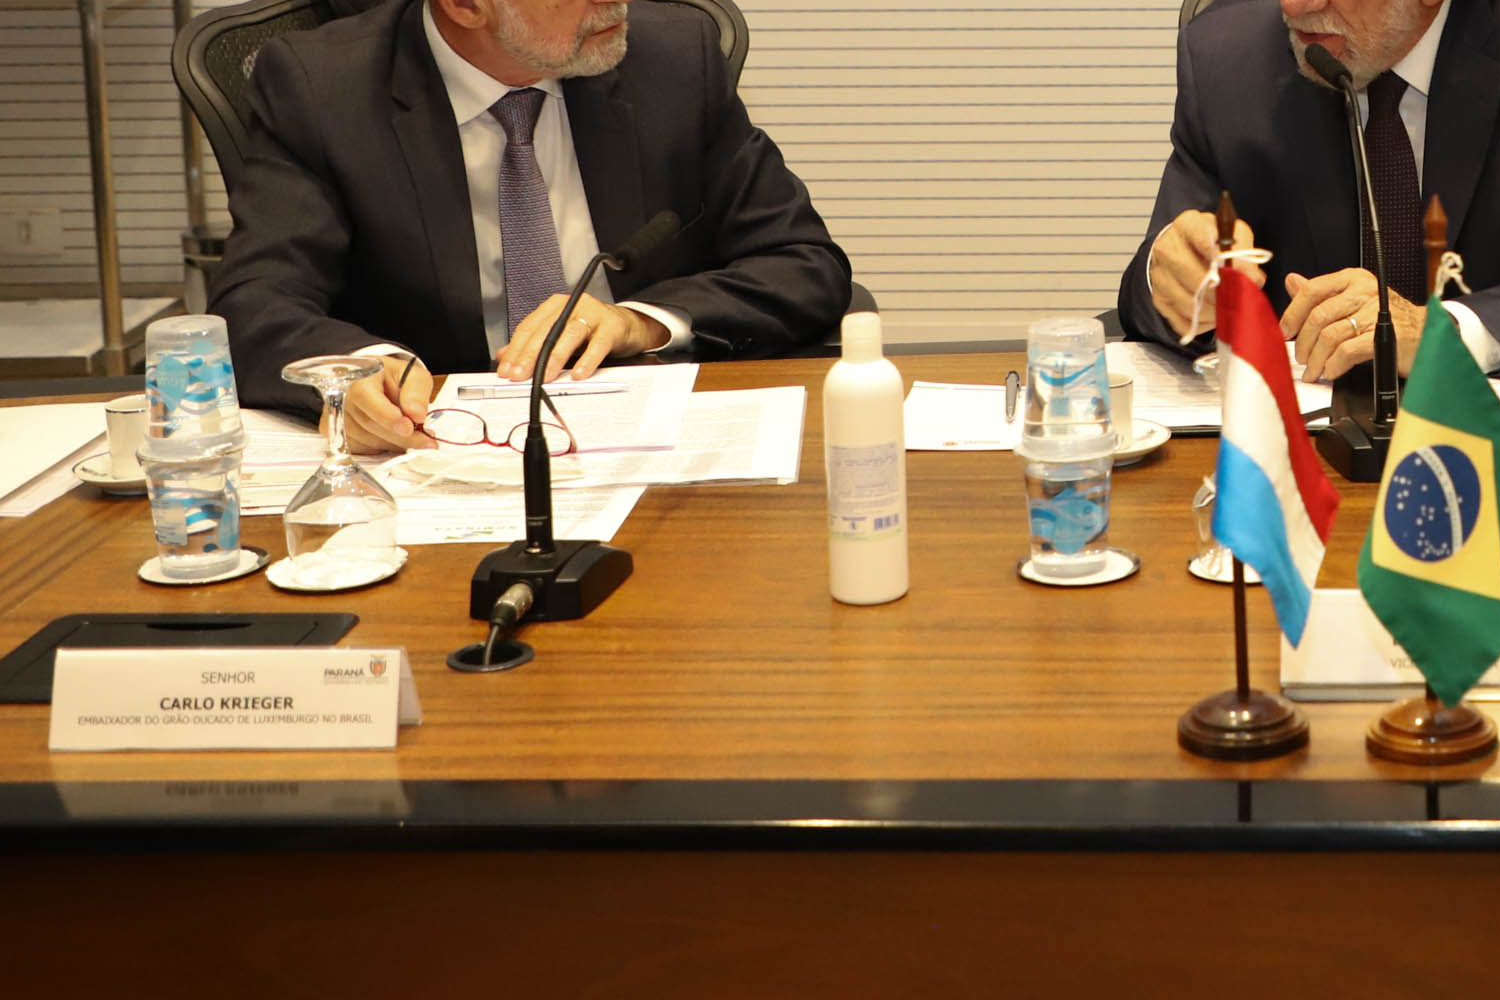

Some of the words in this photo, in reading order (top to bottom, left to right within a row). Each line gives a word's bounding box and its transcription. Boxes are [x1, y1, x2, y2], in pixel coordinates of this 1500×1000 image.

[201, 671, 255, 684] SENHOR
[324, 668, 365, 677] PARANÁ
[160, 697, 215, 710] CARLO
[220, 696, 293, 709] KRIEGER
[78, 715, 141, 725] EMBAIXADOR
[145, 715, 159, 725] DO
[237, 714, 250, 724] DE
[254, 714, 318, 724] LUXEMBURGO
[322, 714, 336, 724] NO
[340, 713, 372, 723] BRASIL
